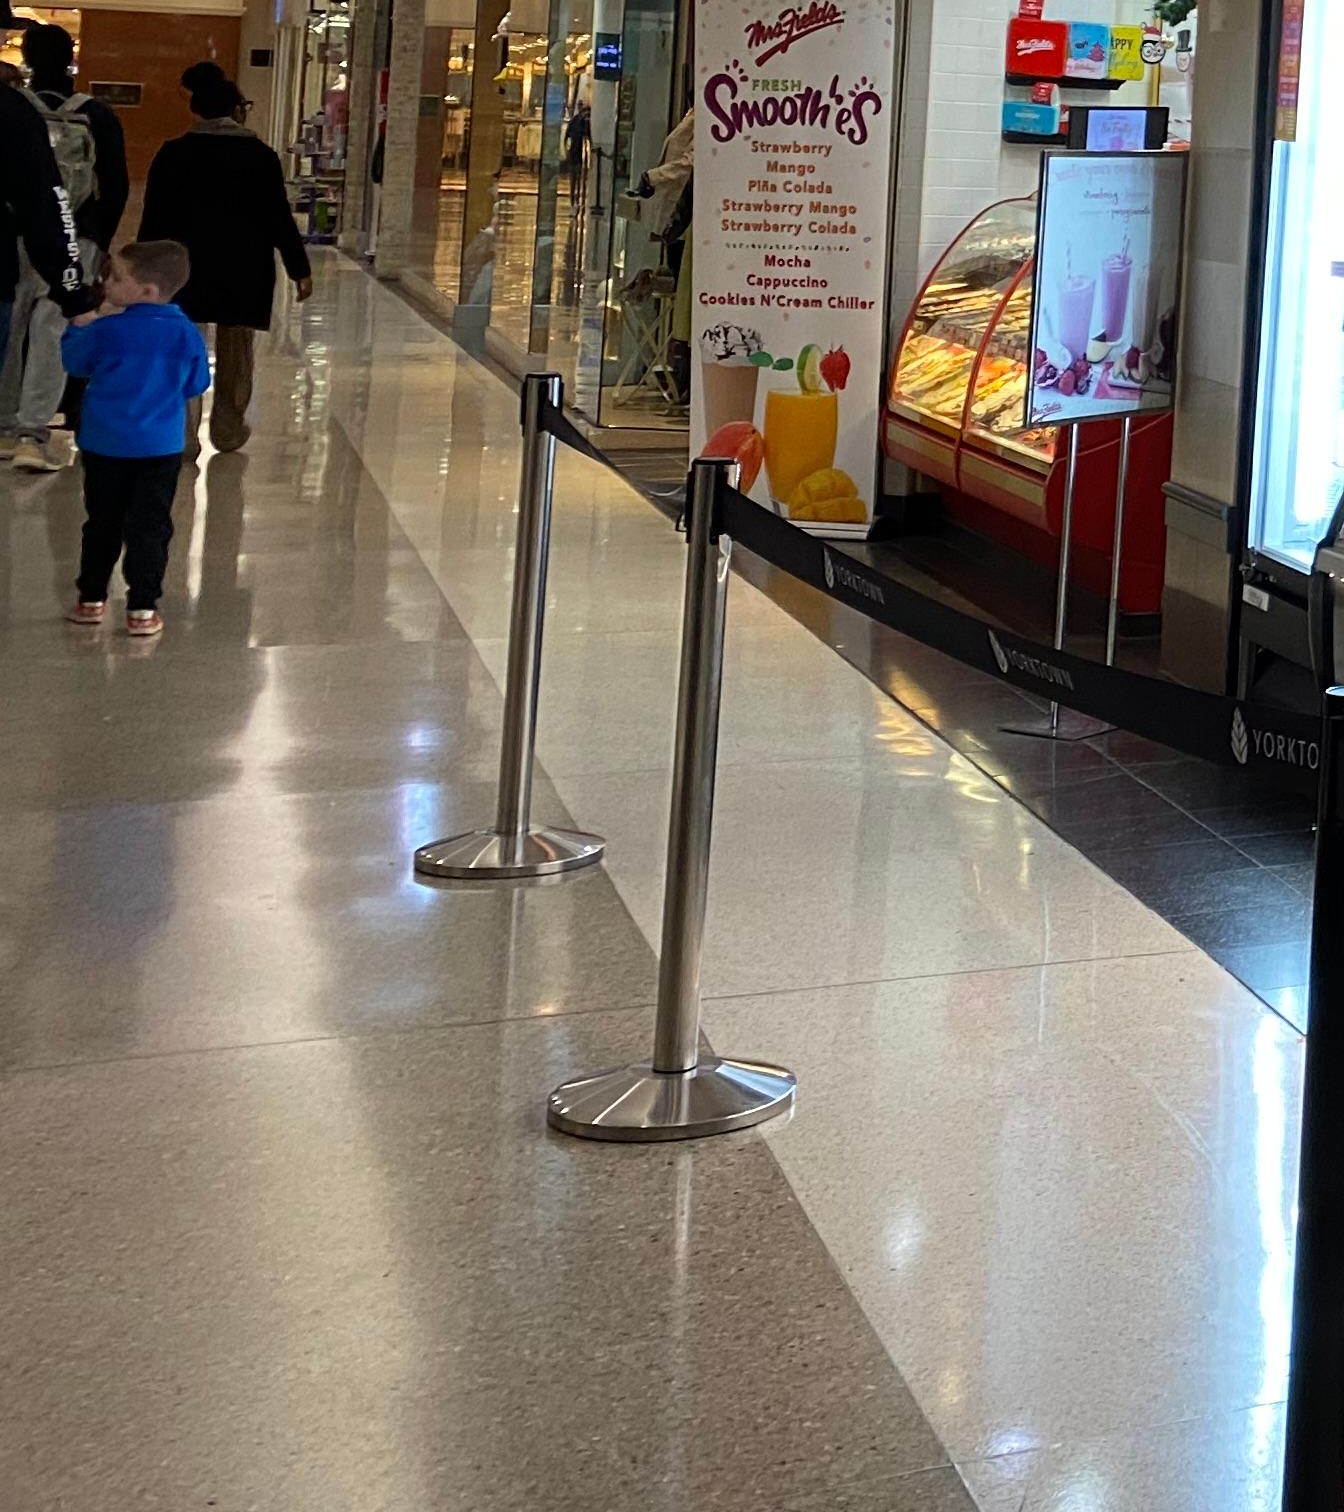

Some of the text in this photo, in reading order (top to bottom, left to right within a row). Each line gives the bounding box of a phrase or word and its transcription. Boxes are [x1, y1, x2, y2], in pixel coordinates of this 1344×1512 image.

[752, 79, 801, 93] FRESH
[751, 140, 833, 158] Strawberry
[766, 160, 816, 177] Mango
[748, 180, 833, 194] Piña Colada
[721, 198, 858, 218] Strawberry Mango
[721, 219, 857, 236] Strawberry Colada
[764, 254, 812, 268] Mocha
[746, 274, 829, 290] Cappuccino
[699, 292, 876, 310] Cookies N'Cream Chiller
[1252, 728, 1320, 771] YORKTO
